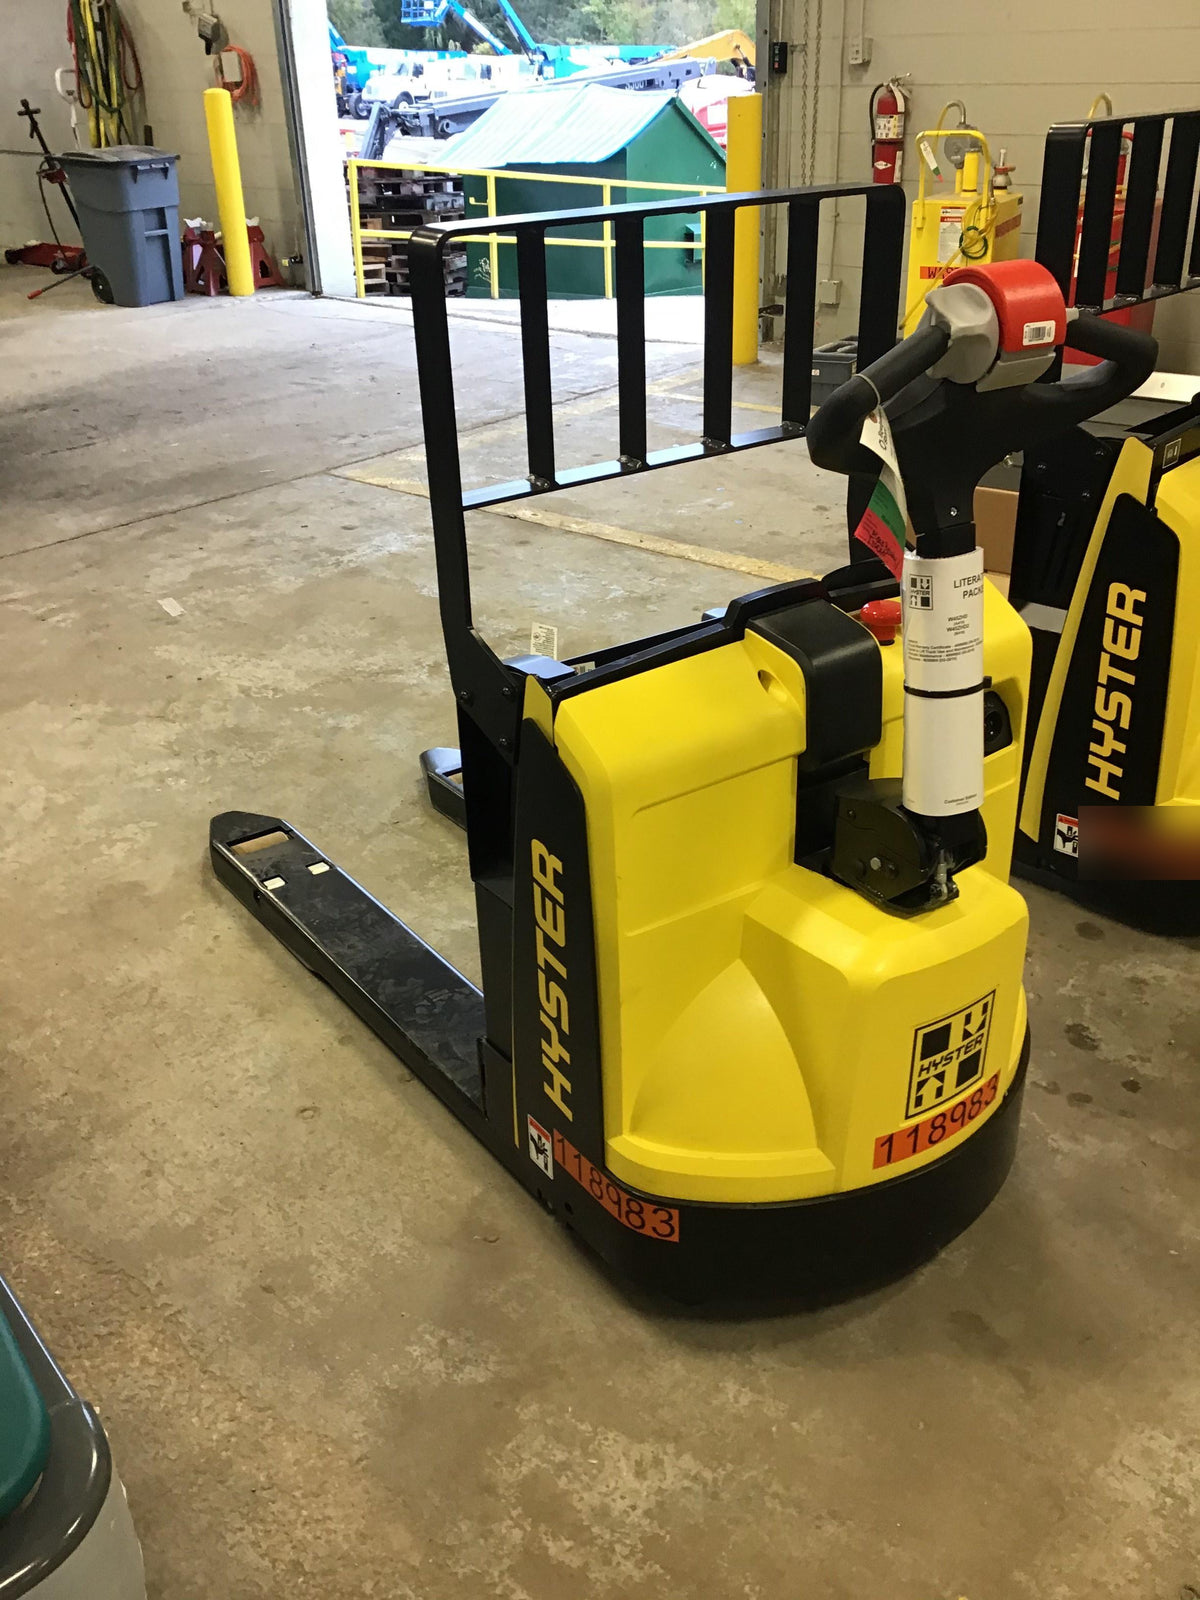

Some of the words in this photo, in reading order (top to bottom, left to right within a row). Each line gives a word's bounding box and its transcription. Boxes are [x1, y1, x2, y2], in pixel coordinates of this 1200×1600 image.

[953, 573, 984, 588] LITERA
[1085, 582, 1147, 800] HYSTER
[531, 838, 573, 1122] HYSTER
[918, 1032, 984, 1078] HYSTER
[880, 1072, 999, 1164] 118983
[557, 1138, 676, 1238] 118983
